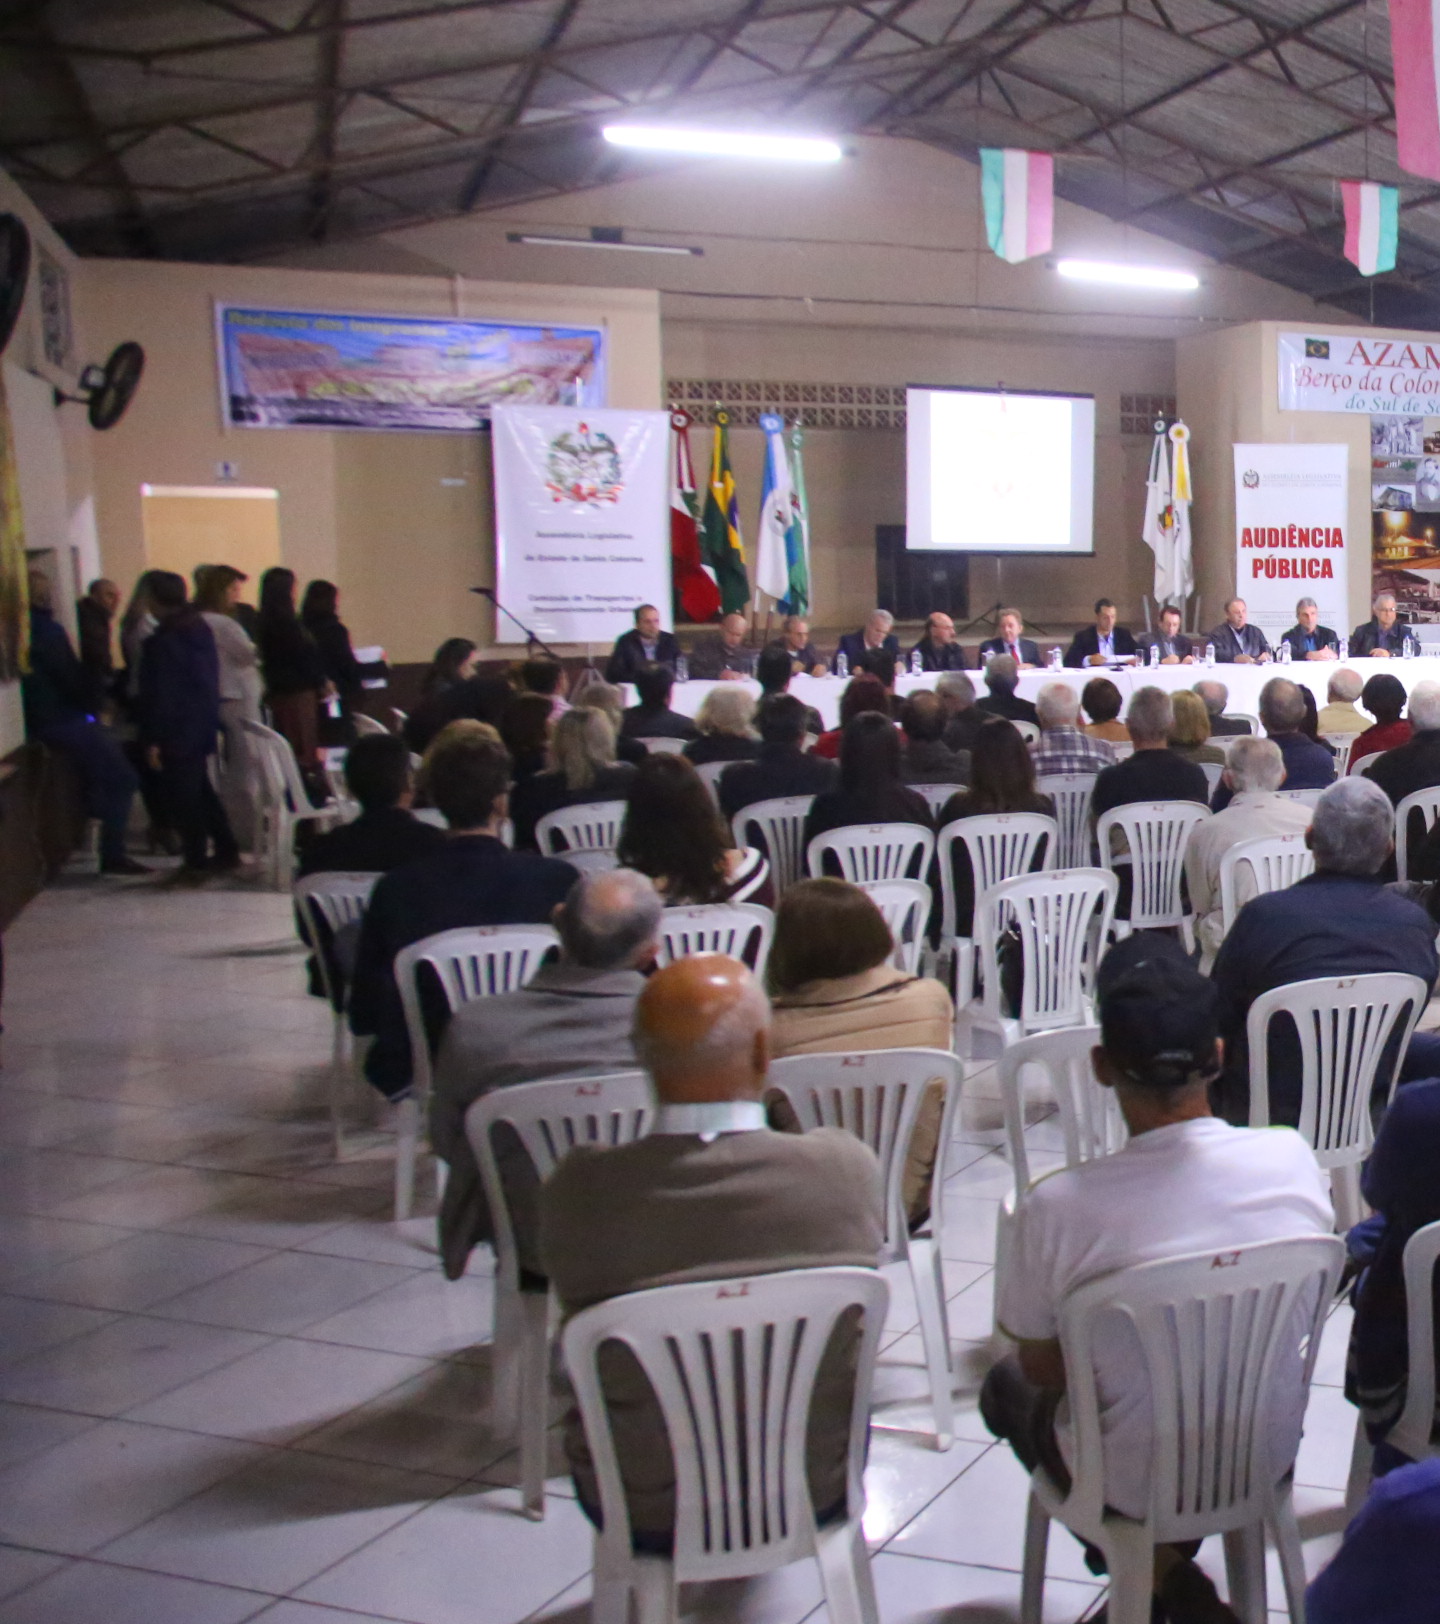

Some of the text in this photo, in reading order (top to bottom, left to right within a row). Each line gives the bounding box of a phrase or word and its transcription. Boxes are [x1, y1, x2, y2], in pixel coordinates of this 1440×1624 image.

[1296, 365, 1352, 393] Berço
[1358, 367, 1382, 391] da
[1345, 393, 1366, 410] do
[1369, 395, 1396, 412] Sul
[1402, 396, 1422, 413] de
[1241, 523, 1344, 548] AUDIÊNCIA
[1252, 554, 1334, 579] PÚBLICA
